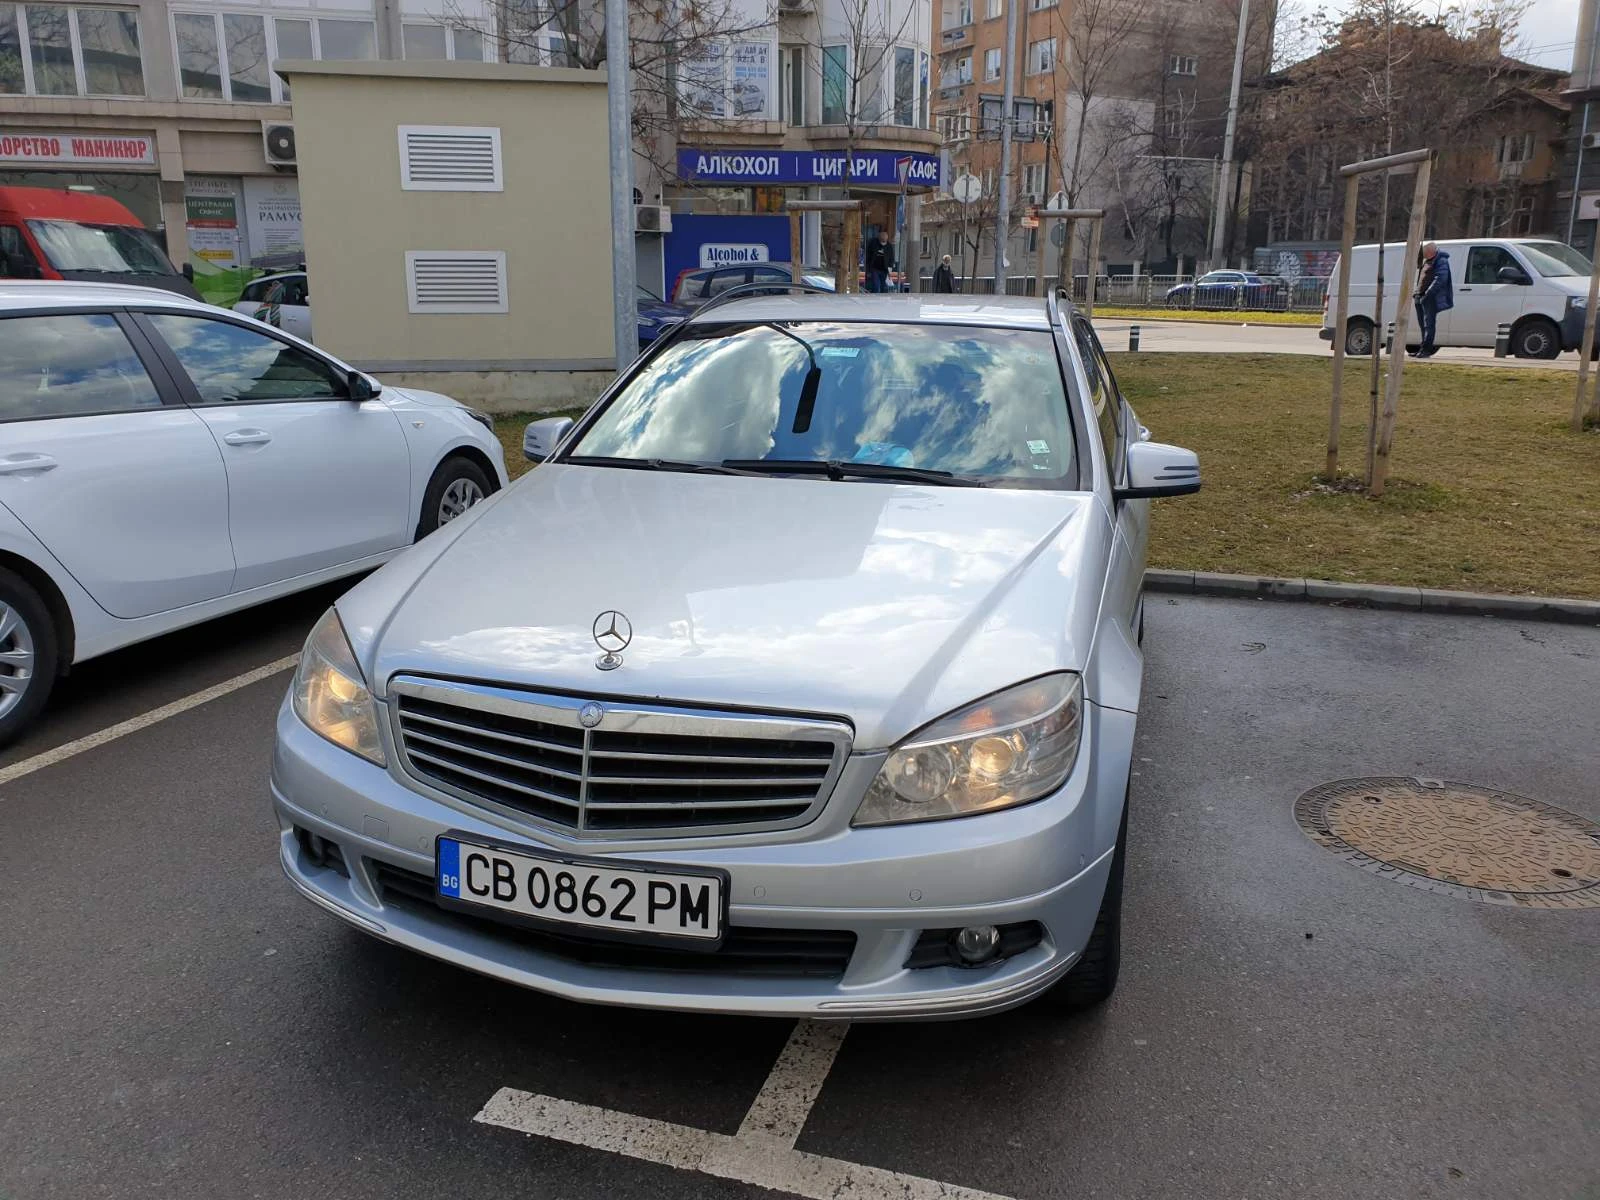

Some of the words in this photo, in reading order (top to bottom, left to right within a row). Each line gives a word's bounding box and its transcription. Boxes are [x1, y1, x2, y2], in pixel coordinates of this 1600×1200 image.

[71, 138, 147, 159] МАНИКЮР
[696, 156, 779, 176] АЛКОХОЛ
[812, 157, 878, 179] ЦИГАРИ
[908, 160, 937, 180] КАФЕ
[707, 247, 748, 261] Alcohol
[750, 248, 760, 261] &
[442, 873, 459, 889] BG
